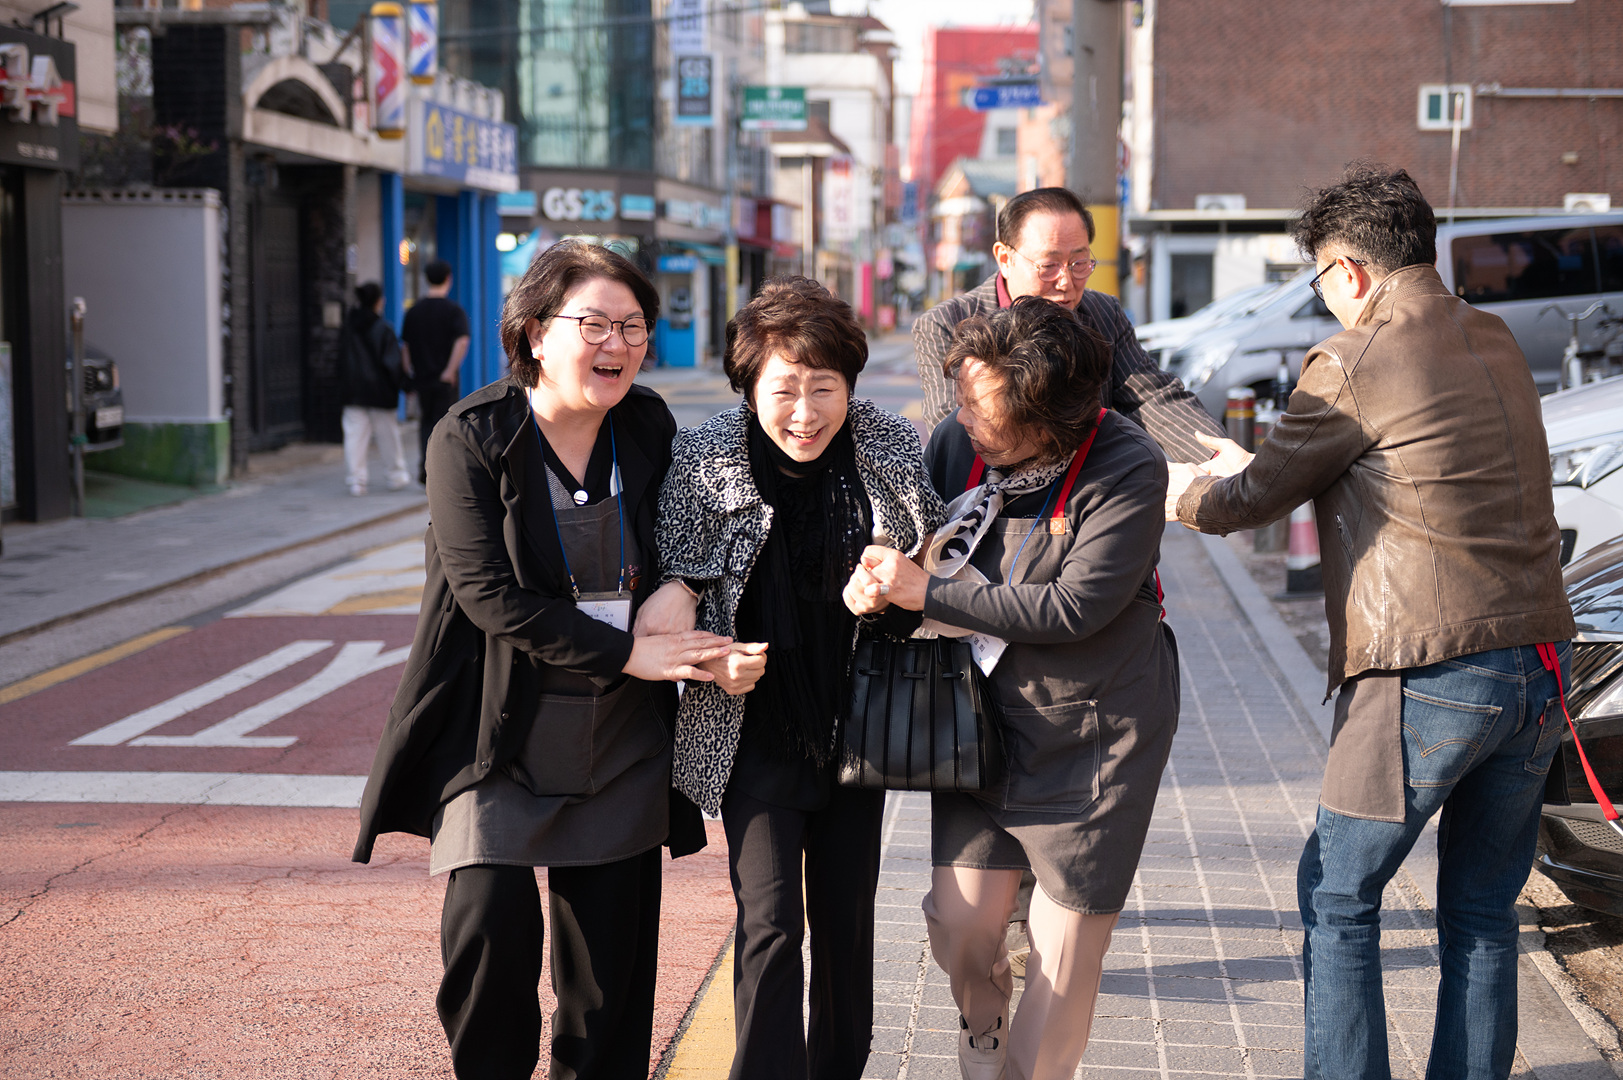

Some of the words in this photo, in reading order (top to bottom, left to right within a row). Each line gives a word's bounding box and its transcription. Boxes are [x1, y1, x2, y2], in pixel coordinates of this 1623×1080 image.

[680, 60, 710, 78] GS
[680, 77, 710, 97] 25
[542, 186, 617, 222] GS25
